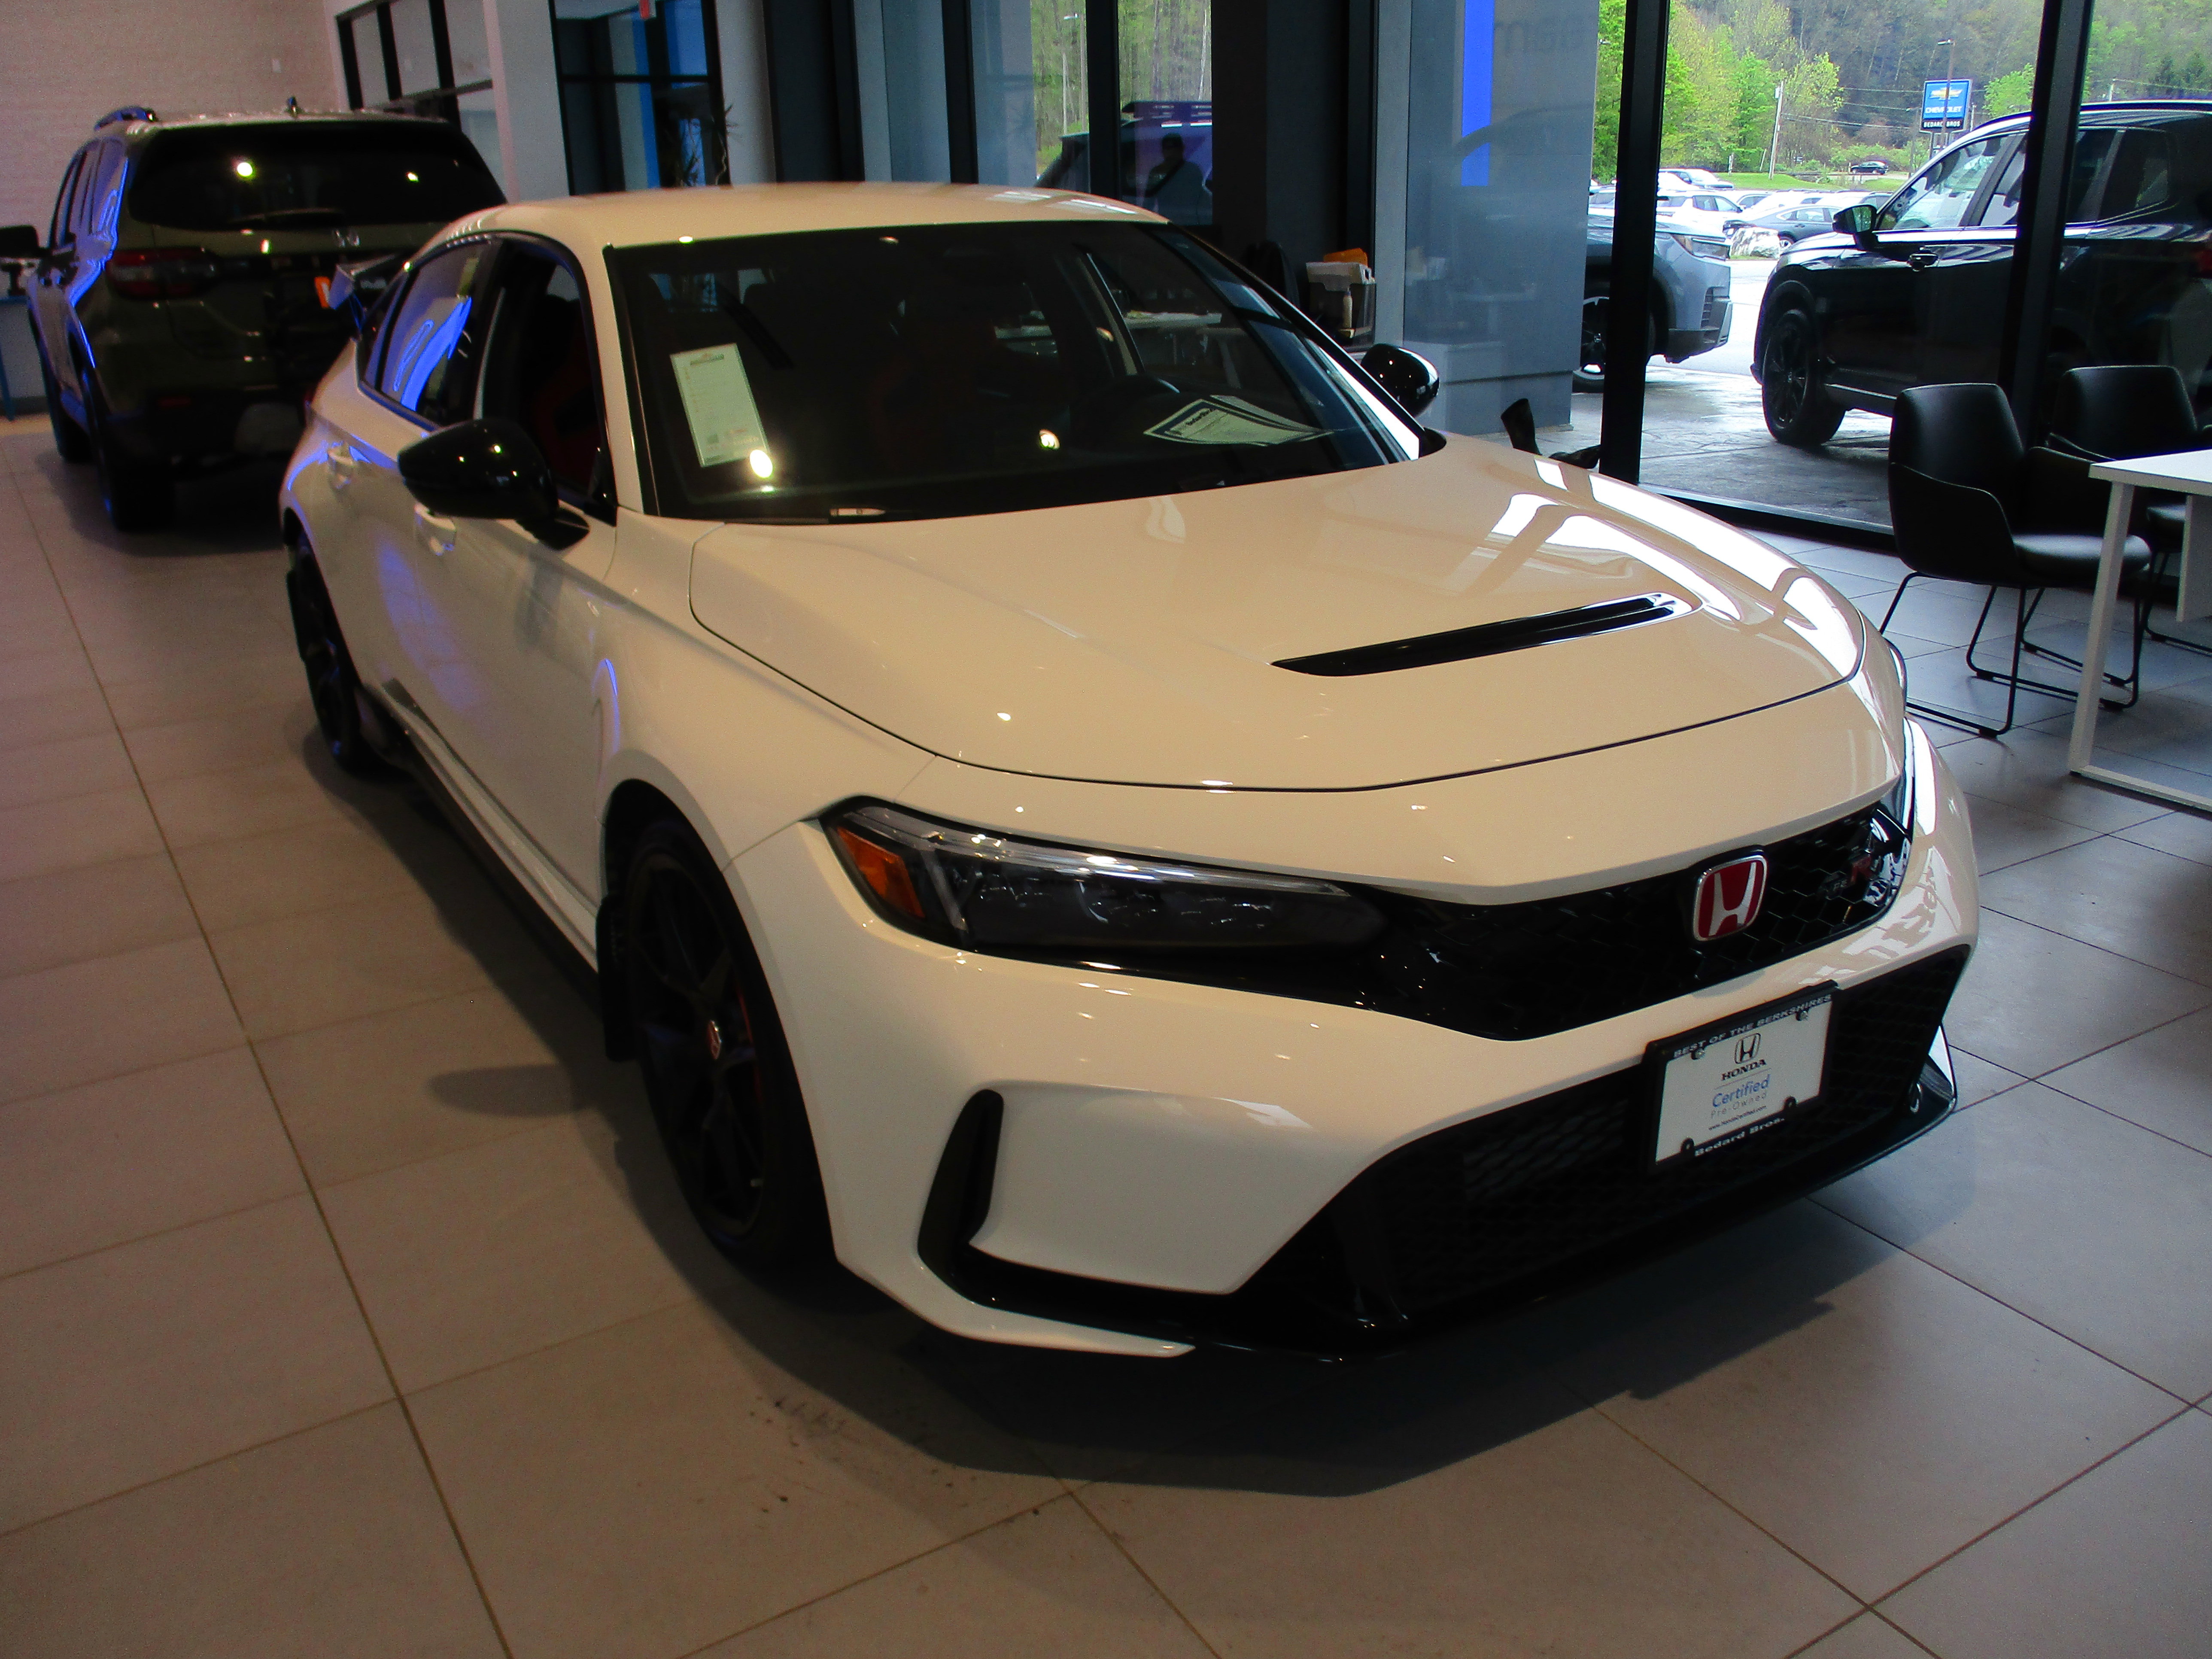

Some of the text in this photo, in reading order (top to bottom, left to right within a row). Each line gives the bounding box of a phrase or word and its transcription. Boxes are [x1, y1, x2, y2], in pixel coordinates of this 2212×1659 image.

[1673, 994, 1832, 1058] BEST OF THE BERKSHIRES
[1721, 1059, 1767, 1081] HONDA
[1711, 1090, 1767, 1119] Pre-Owned
[1712, 1073, 1771, 1108] Certified
[1694, 1131, 1745, 1157] Bedard
